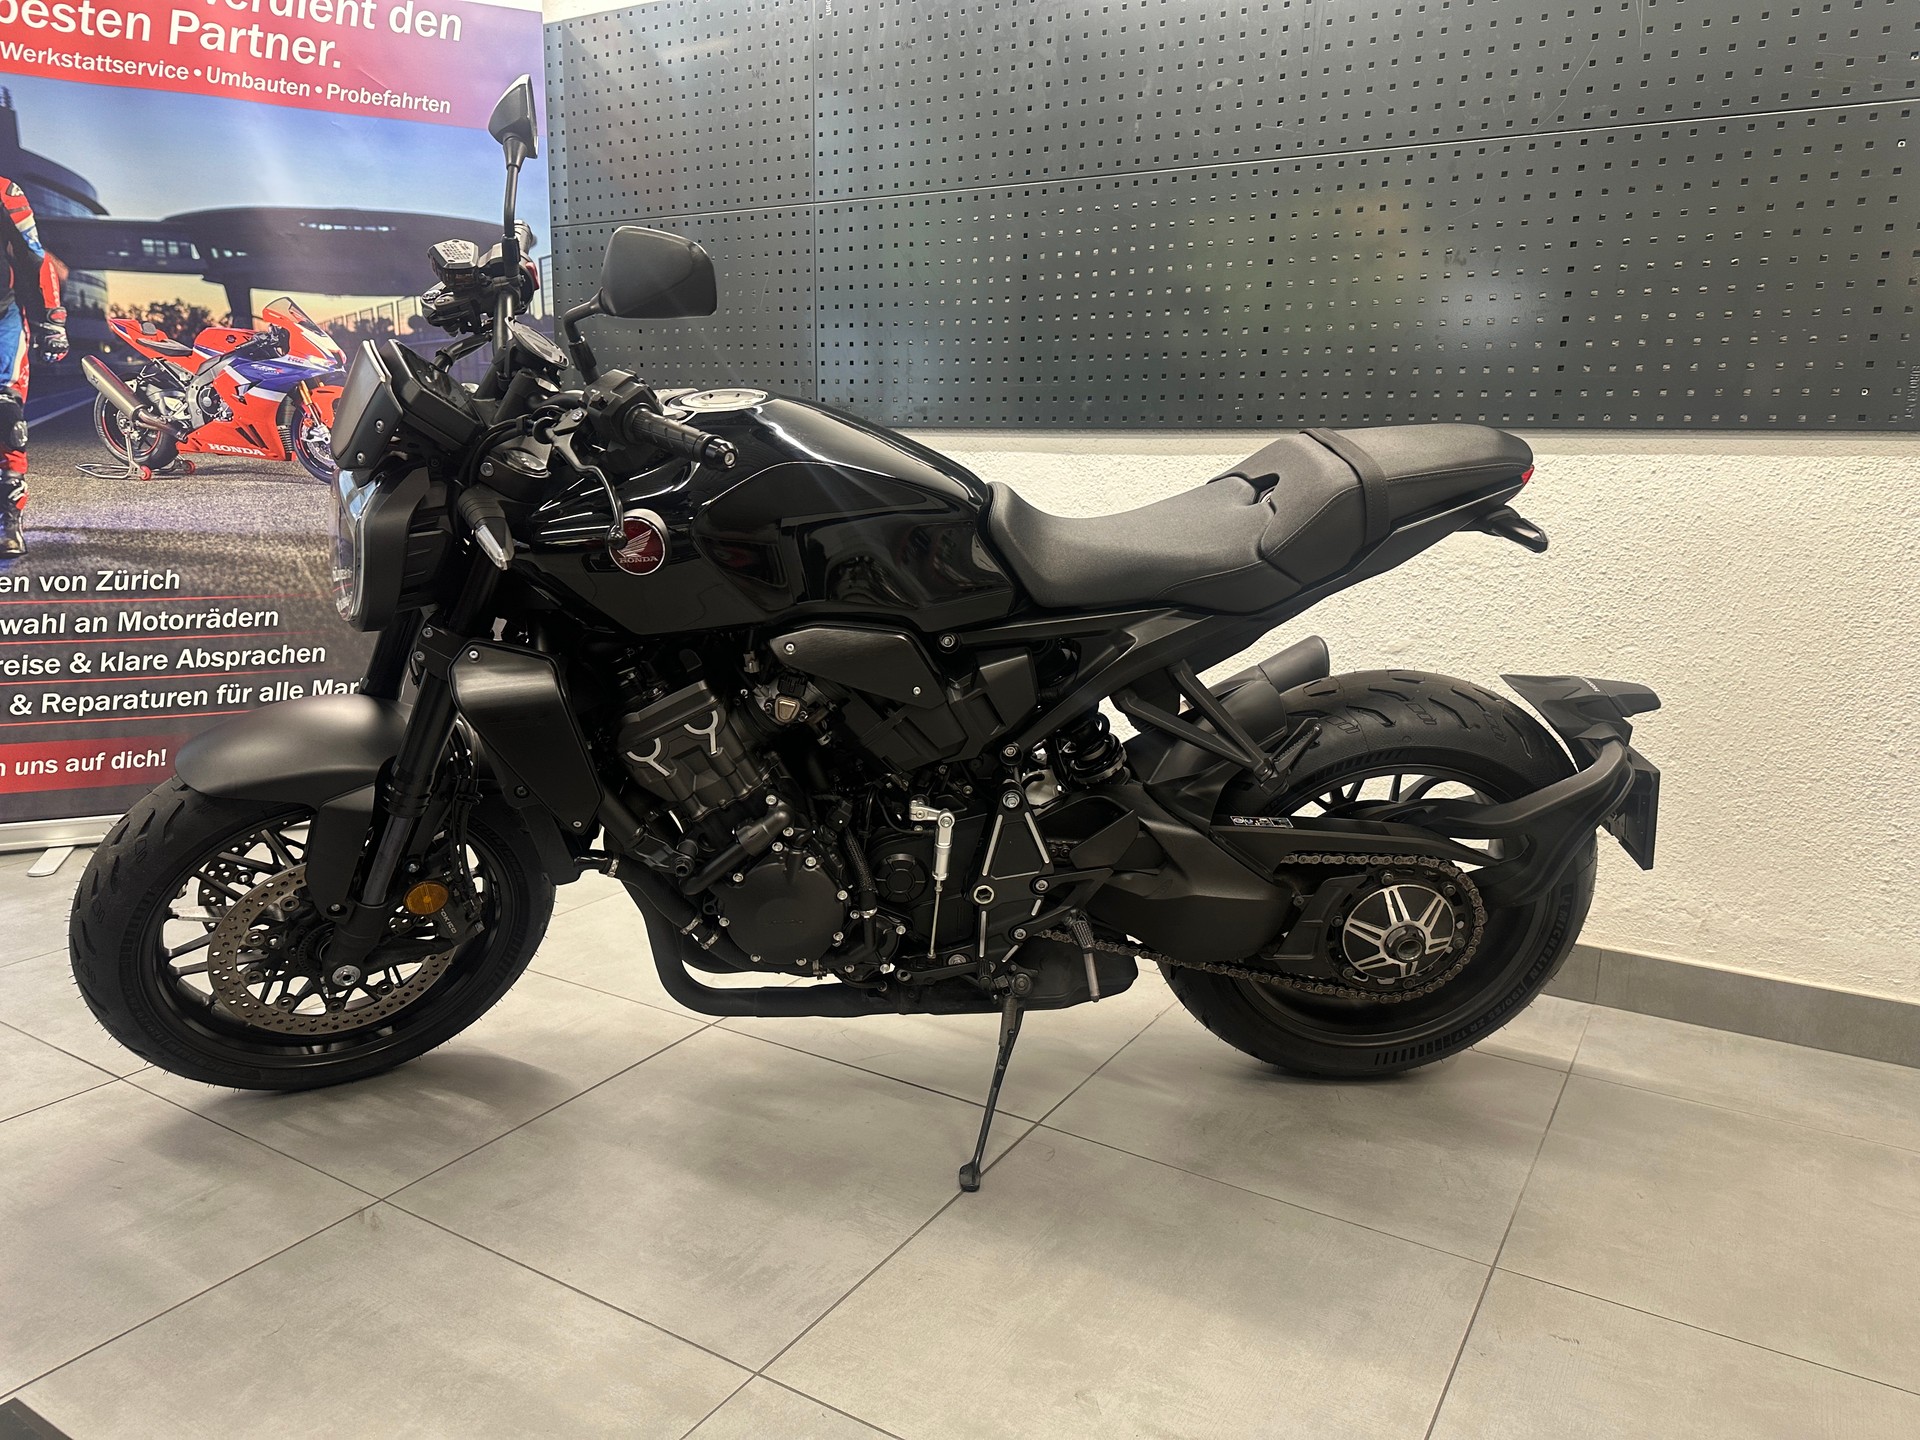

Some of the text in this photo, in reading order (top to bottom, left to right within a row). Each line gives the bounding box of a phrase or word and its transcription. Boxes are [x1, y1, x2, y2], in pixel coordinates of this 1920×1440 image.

[388, 0, 463, 42] den
[169, 8, 341, 69] Partner.
[0, 40, 451, 114] Werkstattservice Umbauten Probefahrten
[207, 443, 266, 456] HONDA
[618, 555, 659, 564] HONDA
[39, 574, 87, 592] von
[95, 569, 180, 591] Zürich
[0, 608, 279, 636] wahl an Motorrädern
[0, 645, 326, 676] eise & klare Absprachen
[9, 677, 363, 717] & Reparaturen für alle Mar
[15, 760, 59, 776] uns
[65, 752, 106, 773] auf
[111, 749, 167, 770] dich!
[441, 908, 457, 933] OKICO
[1529, 905, 1571, 981] MICHELIN
